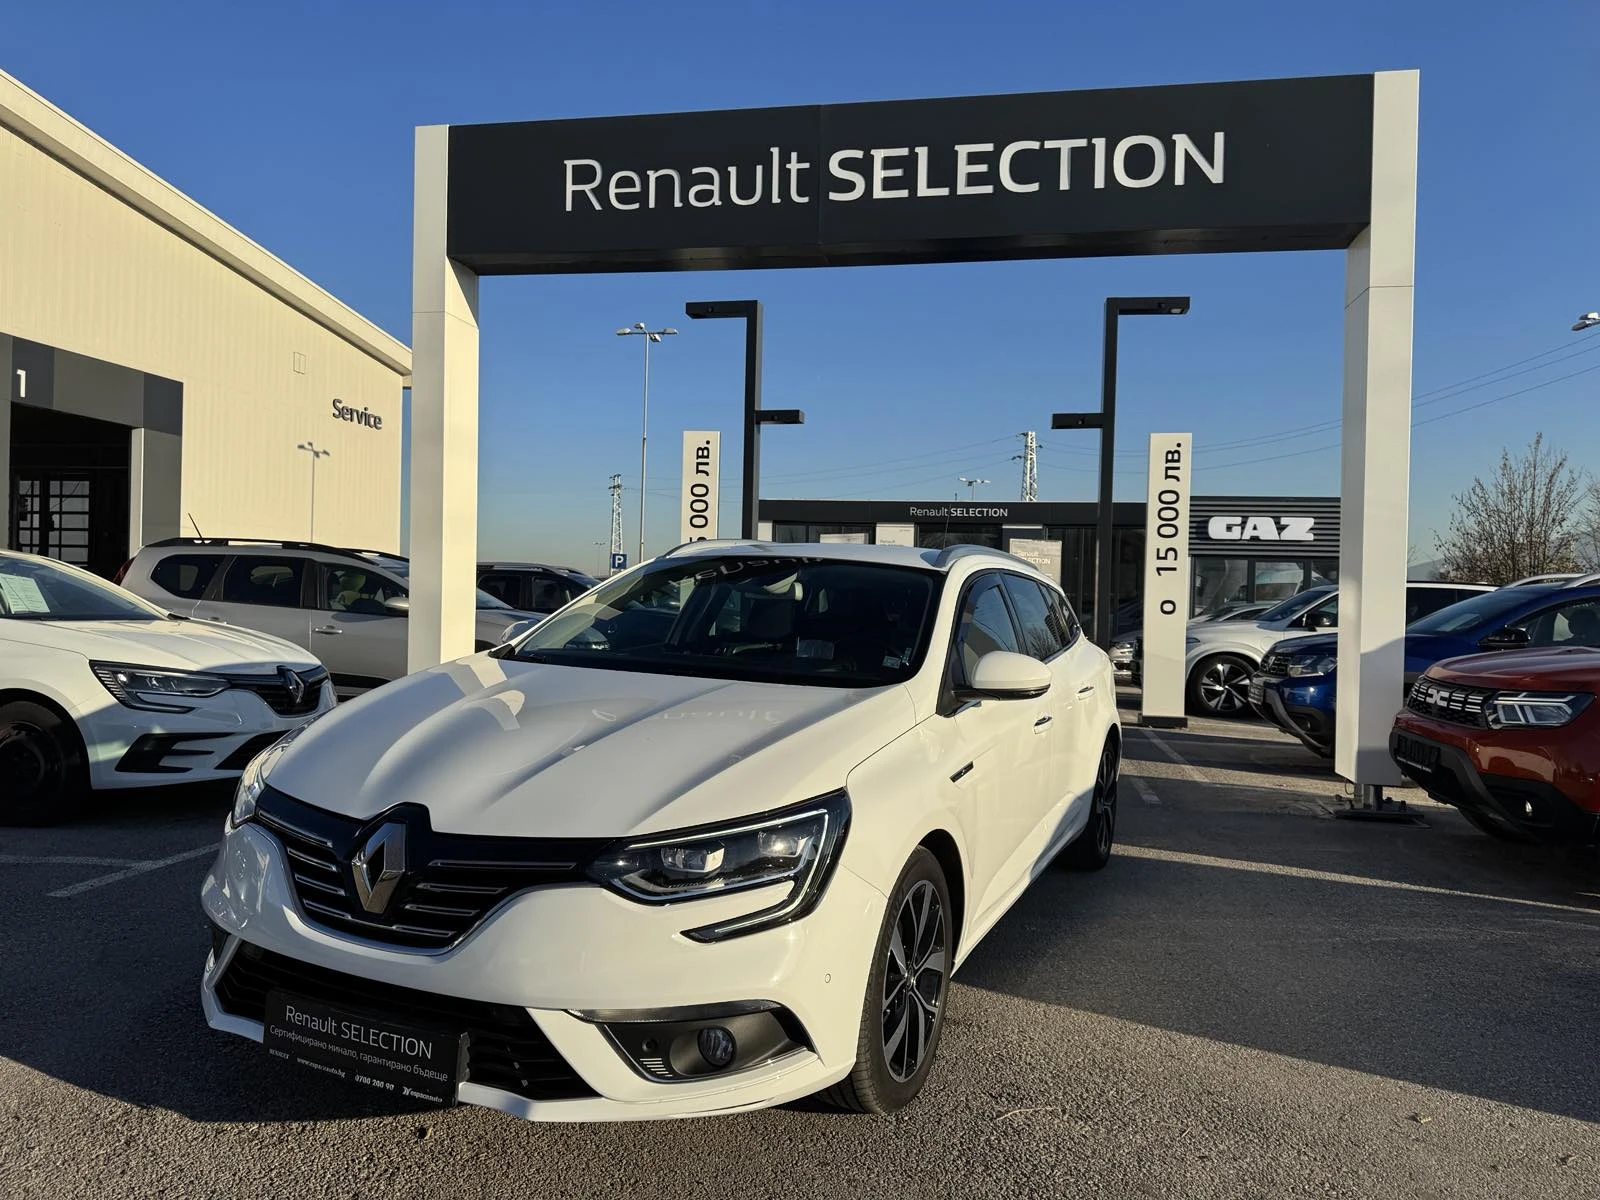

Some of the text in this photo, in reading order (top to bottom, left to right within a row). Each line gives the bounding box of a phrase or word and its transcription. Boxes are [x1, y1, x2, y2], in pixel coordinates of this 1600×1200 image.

[563, 131, 1225, 212] Renault SELECTION
[16, 369, 26, 398] 1
[332, 398, 382, 430] Service
[1164, 442, 1182, 482] лв.
[689, 483, 709, 529] 000
[909, 506, 1008, 517] Renault SELECTION
[1157, 489, 1180, 538] 000
[1208, 516, 1315, 541] GAZ
[615, 555, 624, 568] P
[1156, 547, 1178, 576] 15
[285, 1005, 432, 1059] Renault SELECTION
[269, 1024, 327, 1050] Сертифицирано
[360, 1052, 412, 1073] гарантирано
[413, 1064, 448, 1082] бъдеще
